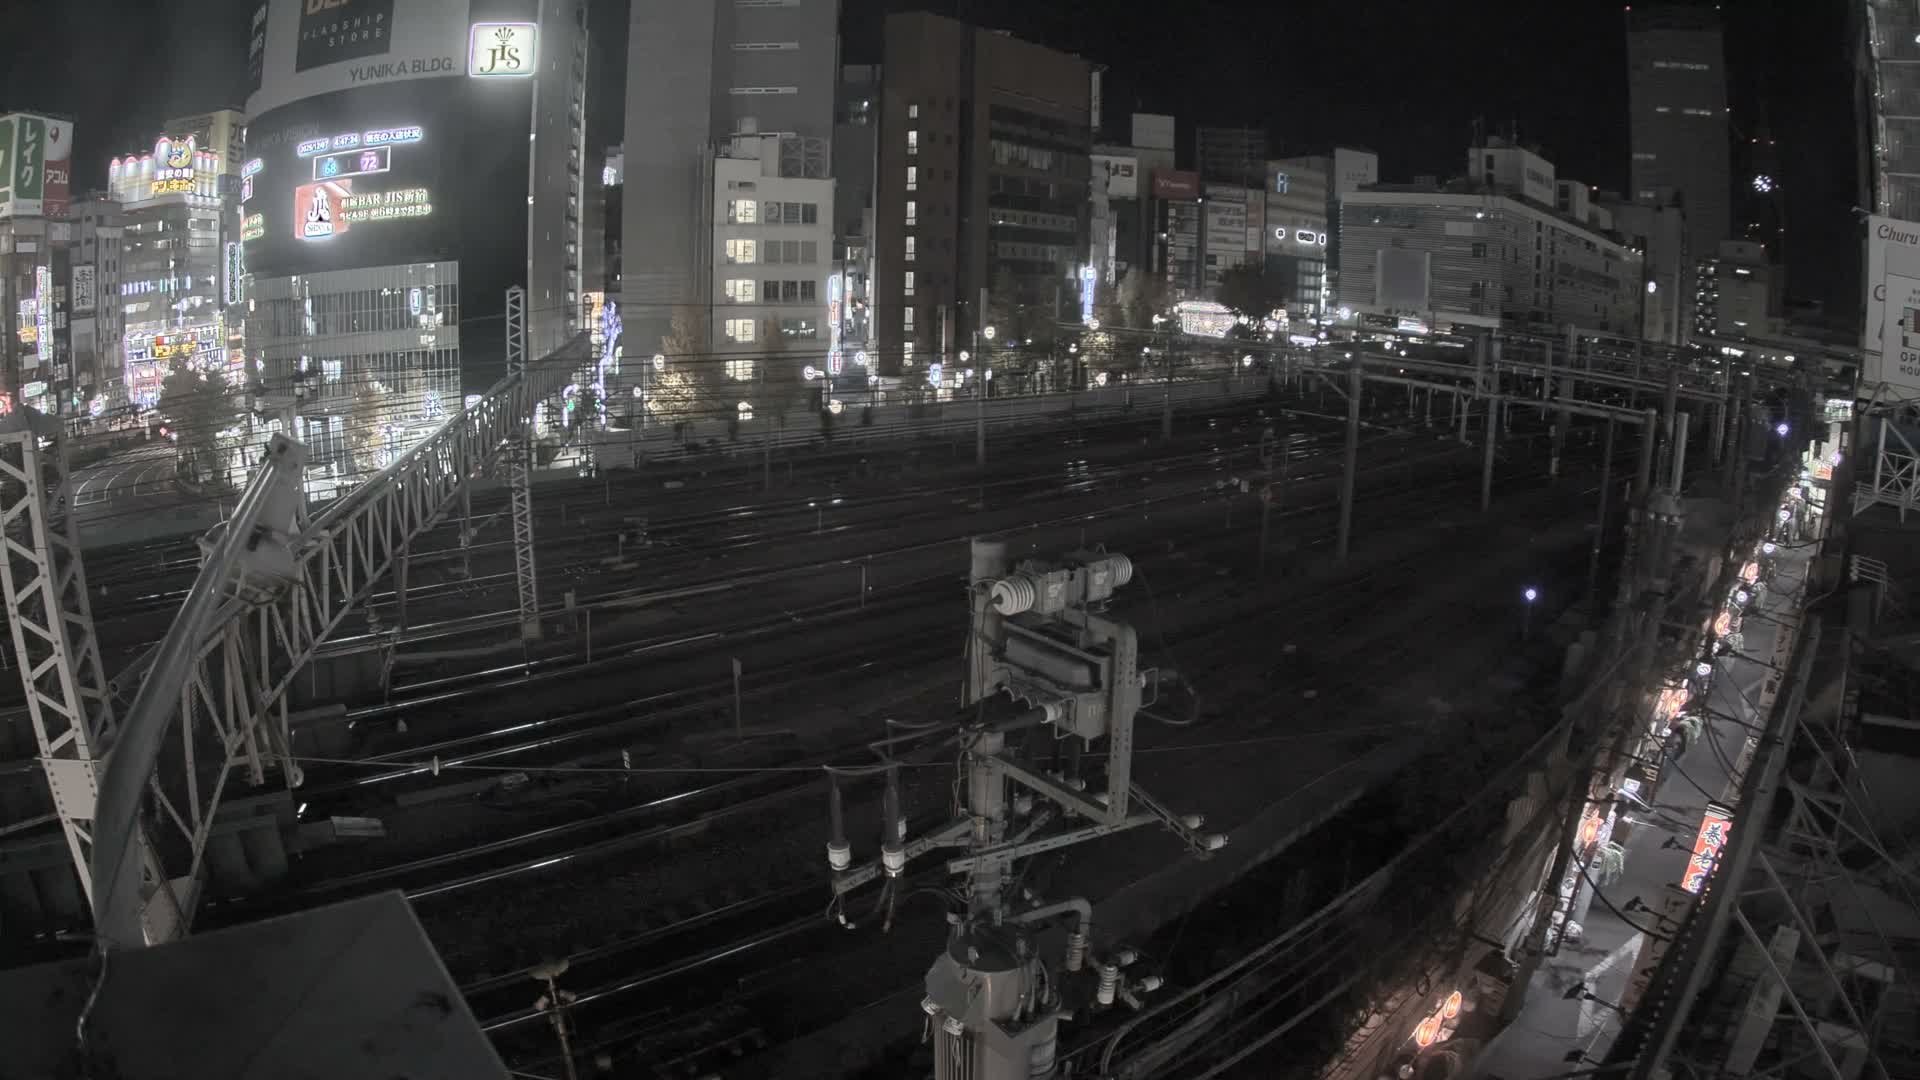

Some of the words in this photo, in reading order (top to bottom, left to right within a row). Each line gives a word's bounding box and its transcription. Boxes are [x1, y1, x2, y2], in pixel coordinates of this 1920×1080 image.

[303, 13, 384, 41] FLAGSHIP
[328, 28, 384, 47] STORE
[350, 61, 407, 81] YUNIKA
[411, 57, 456, 75] BLDG.
[479, 43, 521, 73] JIS
[22, 120, 37, 188] レイク
[324, 163, 337, 175] 68
[360, 156, 378, 170] 72
[46, 169, 69, 185] アコム
